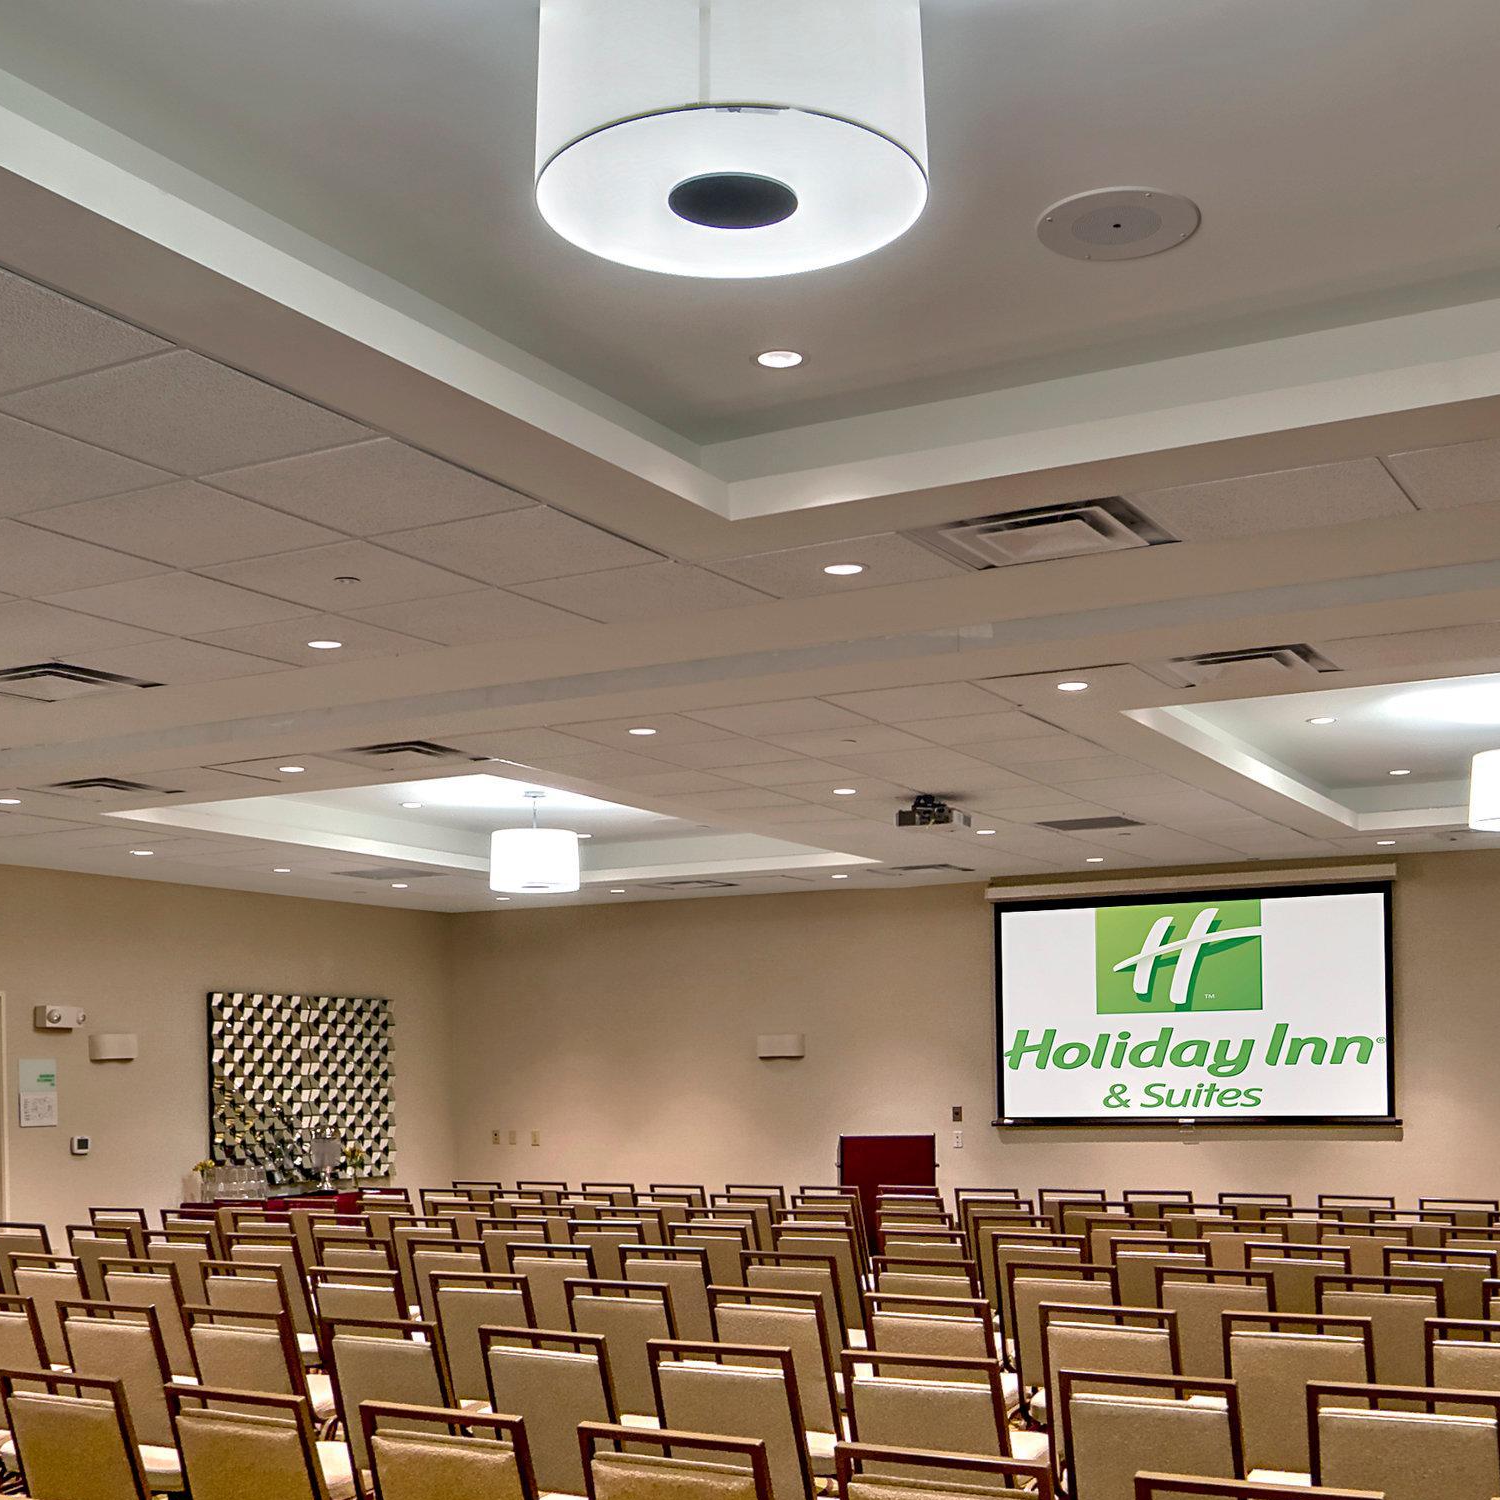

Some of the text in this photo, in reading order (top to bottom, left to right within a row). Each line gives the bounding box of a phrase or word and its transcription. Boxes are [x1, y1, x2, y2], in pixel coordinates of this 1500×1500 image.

[1005, 1027, 1255, 1077] Holiday
[1103, 1081, 1263, 1108] & Suites
